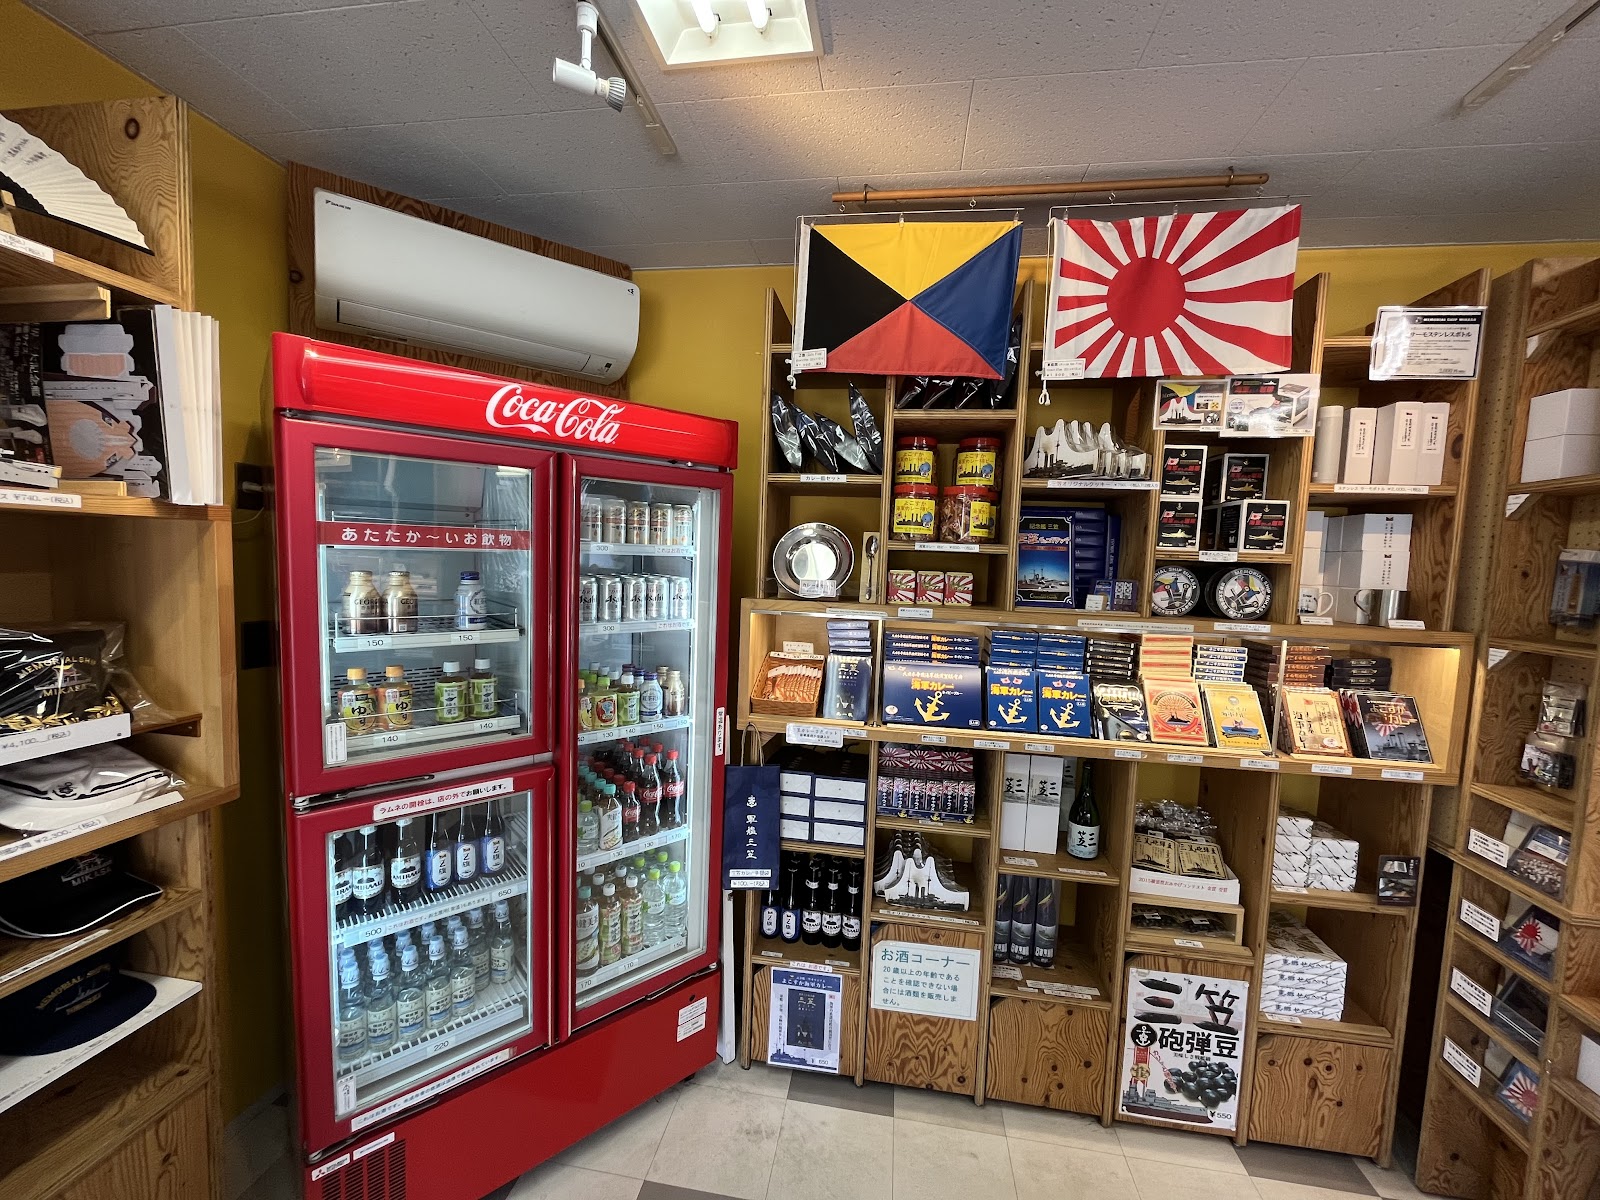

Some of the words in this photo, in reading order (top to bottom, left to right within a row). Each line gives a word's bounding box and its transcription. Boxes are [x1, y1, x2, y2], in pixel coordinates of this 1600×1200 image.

[485, 383, 626, 445] Coca-Cola
[366, 639, 384, 648] 150
[458, 633, 474, 642] 150
[910, 677, 954, 691] 海軍カレー
[990, 683, 1033, 697] 海軍カレー
[1041, 686, 1087, 702] 海軍カレー
[479, 722, 494, 730] 140
[382, 734, 399, 743] 140
[71, 865, 113, 887] MIKASA
[498, 888, 512, 897] 650
[365, 927, 382, 937] 500
[881, 947, 971, 968] お酒コーナー
[623, 961, 634, 970] 170
[580, 978, 592, 988] 170
[882, 977, 958, 992] ことを確認できない場
[882, 986, 957, 1003] 合には酒類を販売しま
[882, 997, 900, 1007] せん。
[434, 1040, 450, 1052] 220
[1158, 1027, 1240, 1060] 砲弾豆
